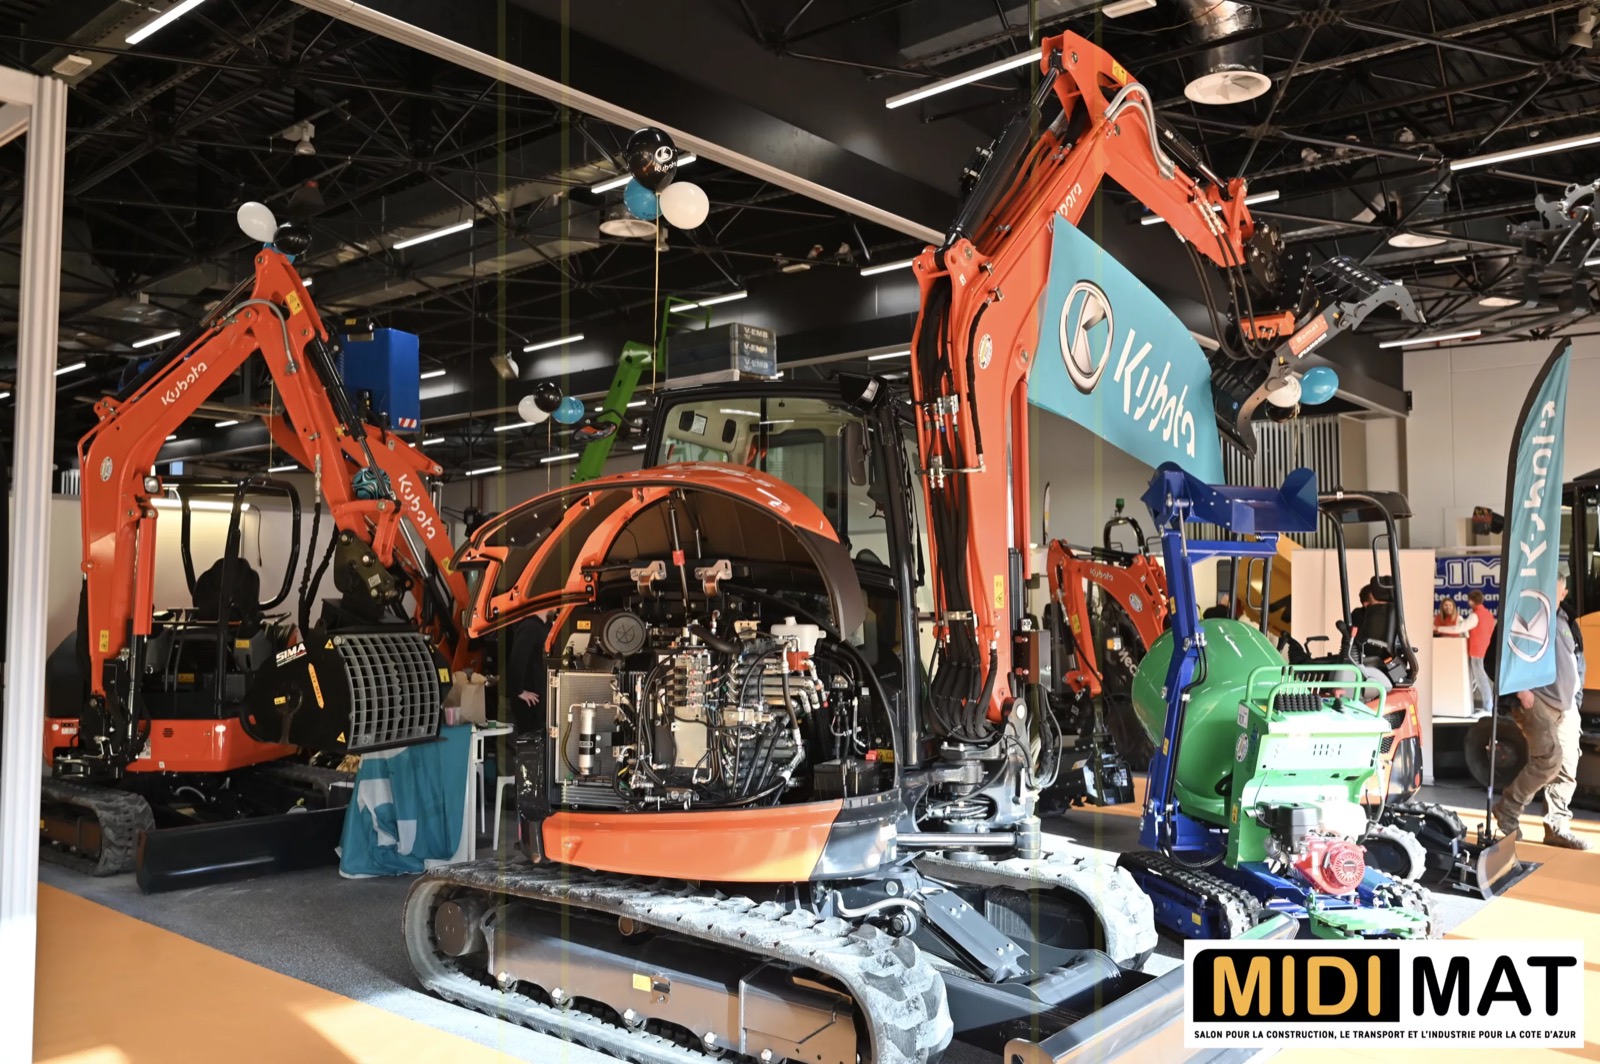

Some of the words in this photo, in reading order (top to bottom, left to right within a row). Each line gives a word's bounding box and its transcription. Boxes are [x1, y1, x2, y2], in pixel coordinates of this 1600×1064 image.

[160, 361, 208, 406] Kubota
[1113, 328, 1196, 458] Kubota
[398, 473, 436, 541] Kubota
[1089, 567, 1114, 582] Kubota
[275, 642, 307, 664] SIMA
